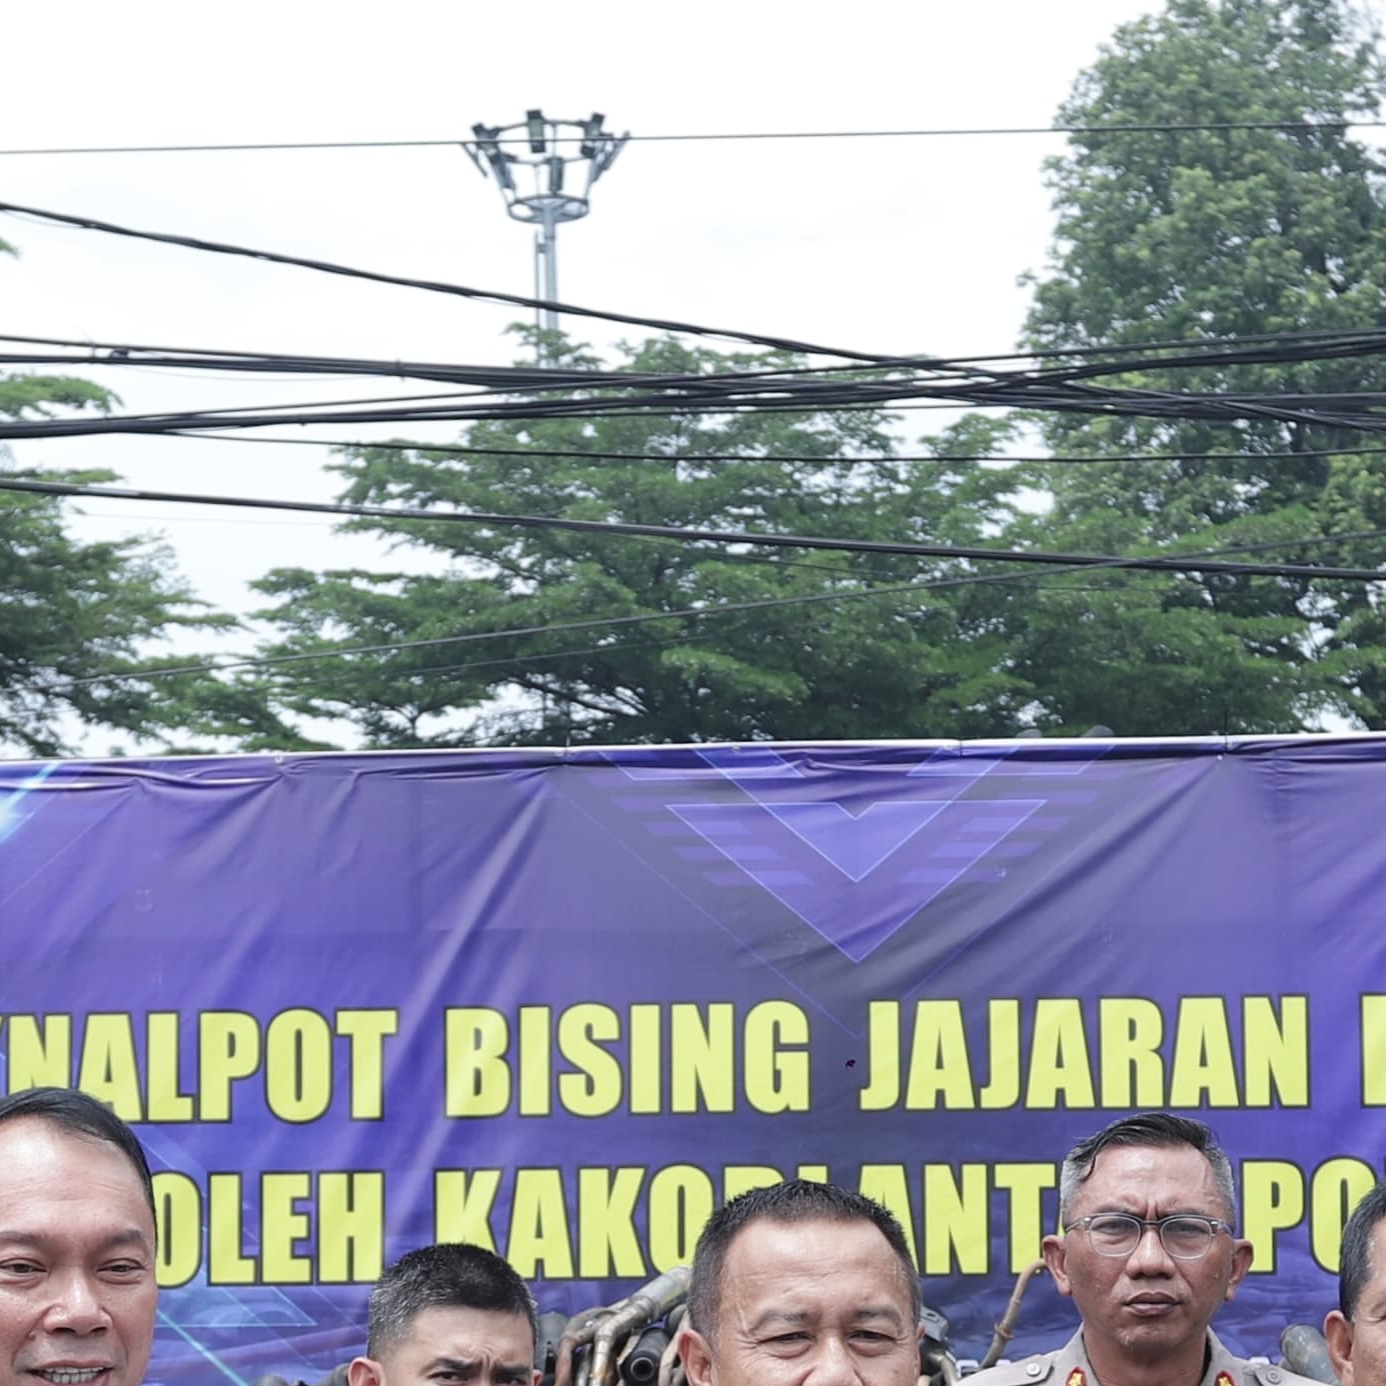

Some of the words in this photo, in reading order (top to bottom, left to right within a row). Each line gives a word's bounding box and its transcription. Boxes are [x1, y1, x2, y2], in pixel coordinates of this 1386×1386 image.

[445, 998, 812, 1117] BISING
[859, 994, 1311, 1111] JAJARAN
[151, 1168, 385, 1289] OLEH
